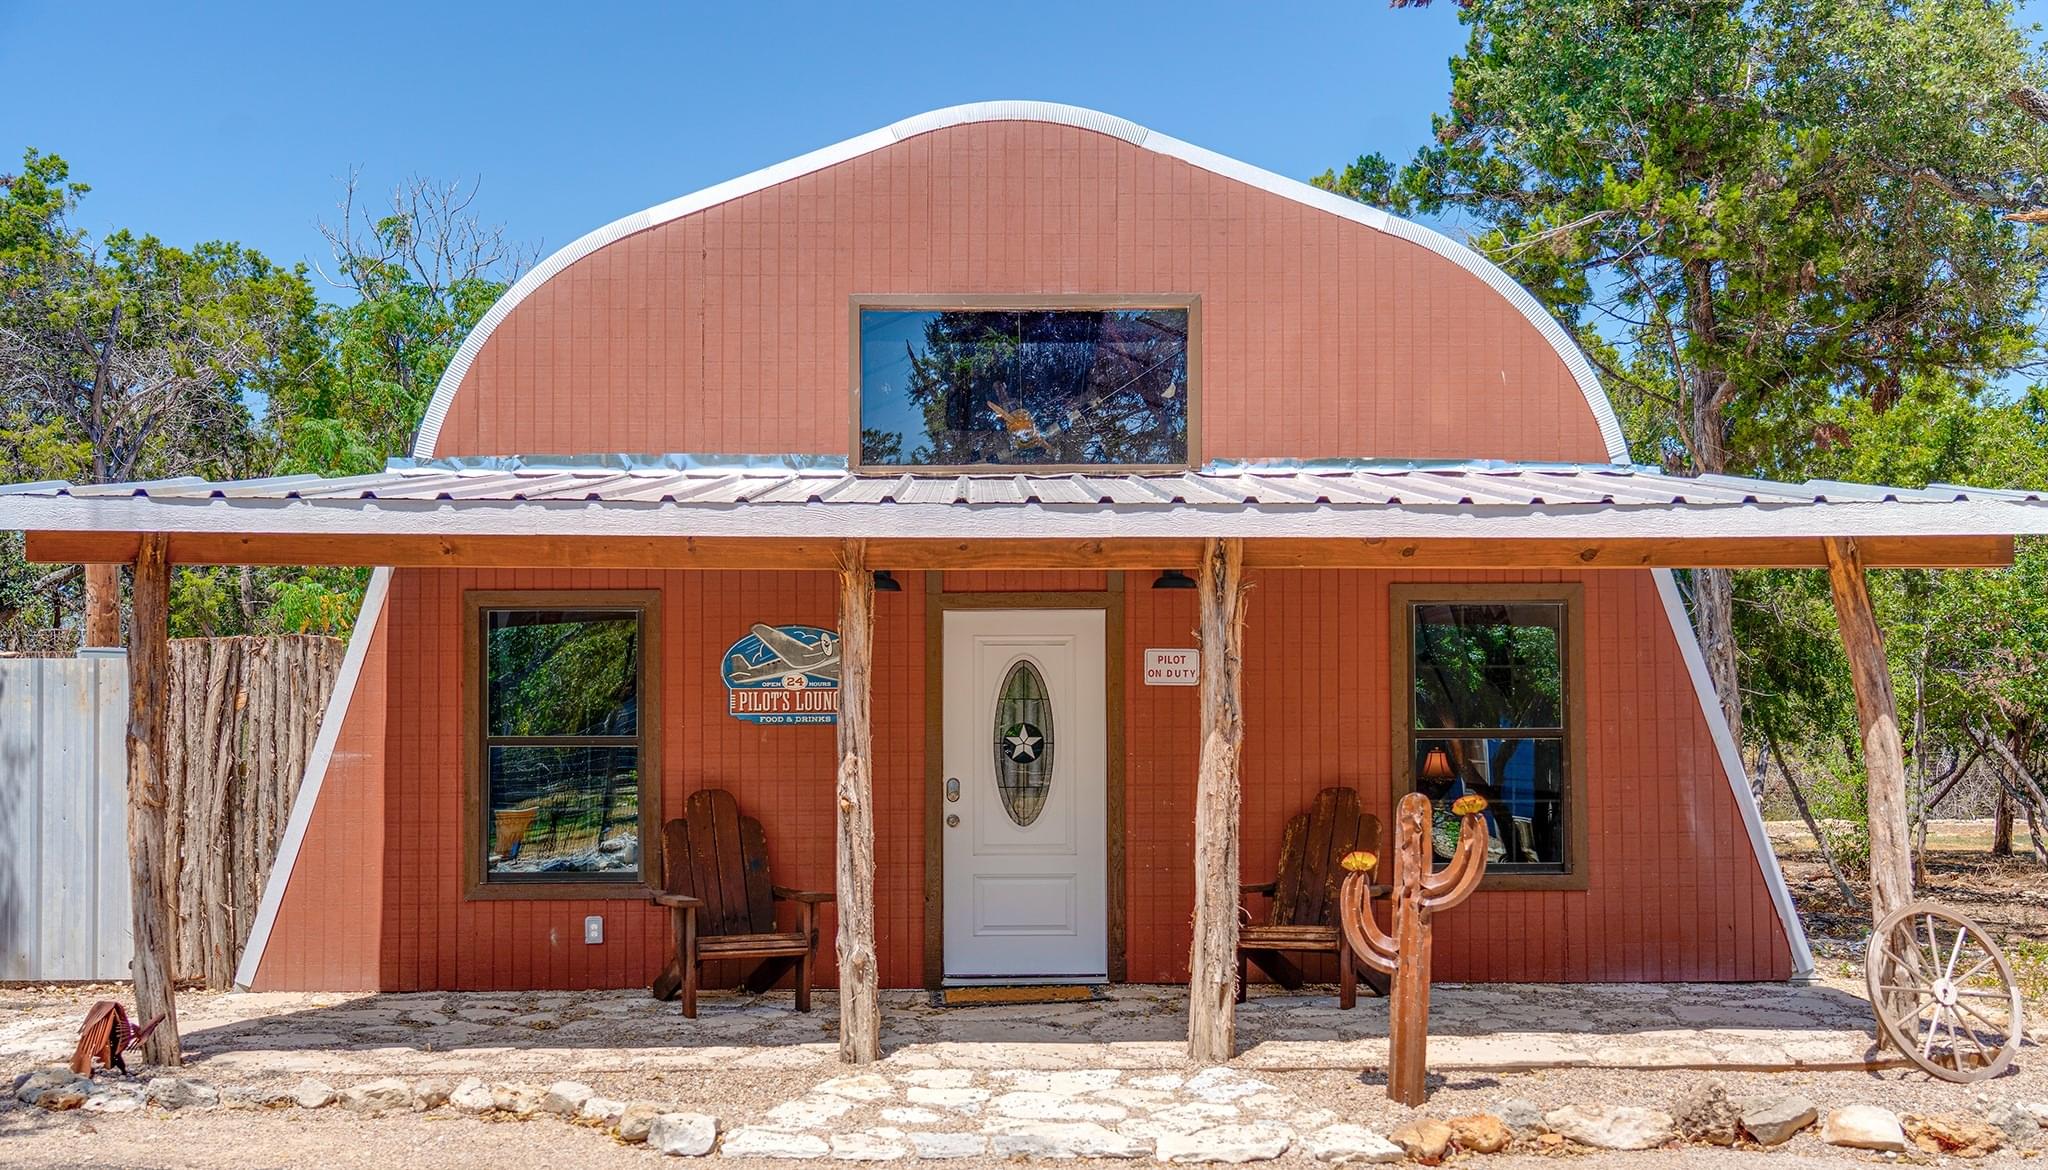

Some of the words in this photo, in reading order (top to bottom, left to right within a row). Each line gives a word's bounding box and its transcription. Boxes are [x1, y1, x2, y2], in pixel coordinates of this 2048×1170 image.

[1157, 655, 1186, 665] PILOT
[1148, 669, 1162, 678] ON
[1166, 669, 1196, 678] DUTY
[787, 677, 804, 686] 24
[739, 690, 790, 711] PILOT'S
[794, 716, 832, 724] DRINKS
